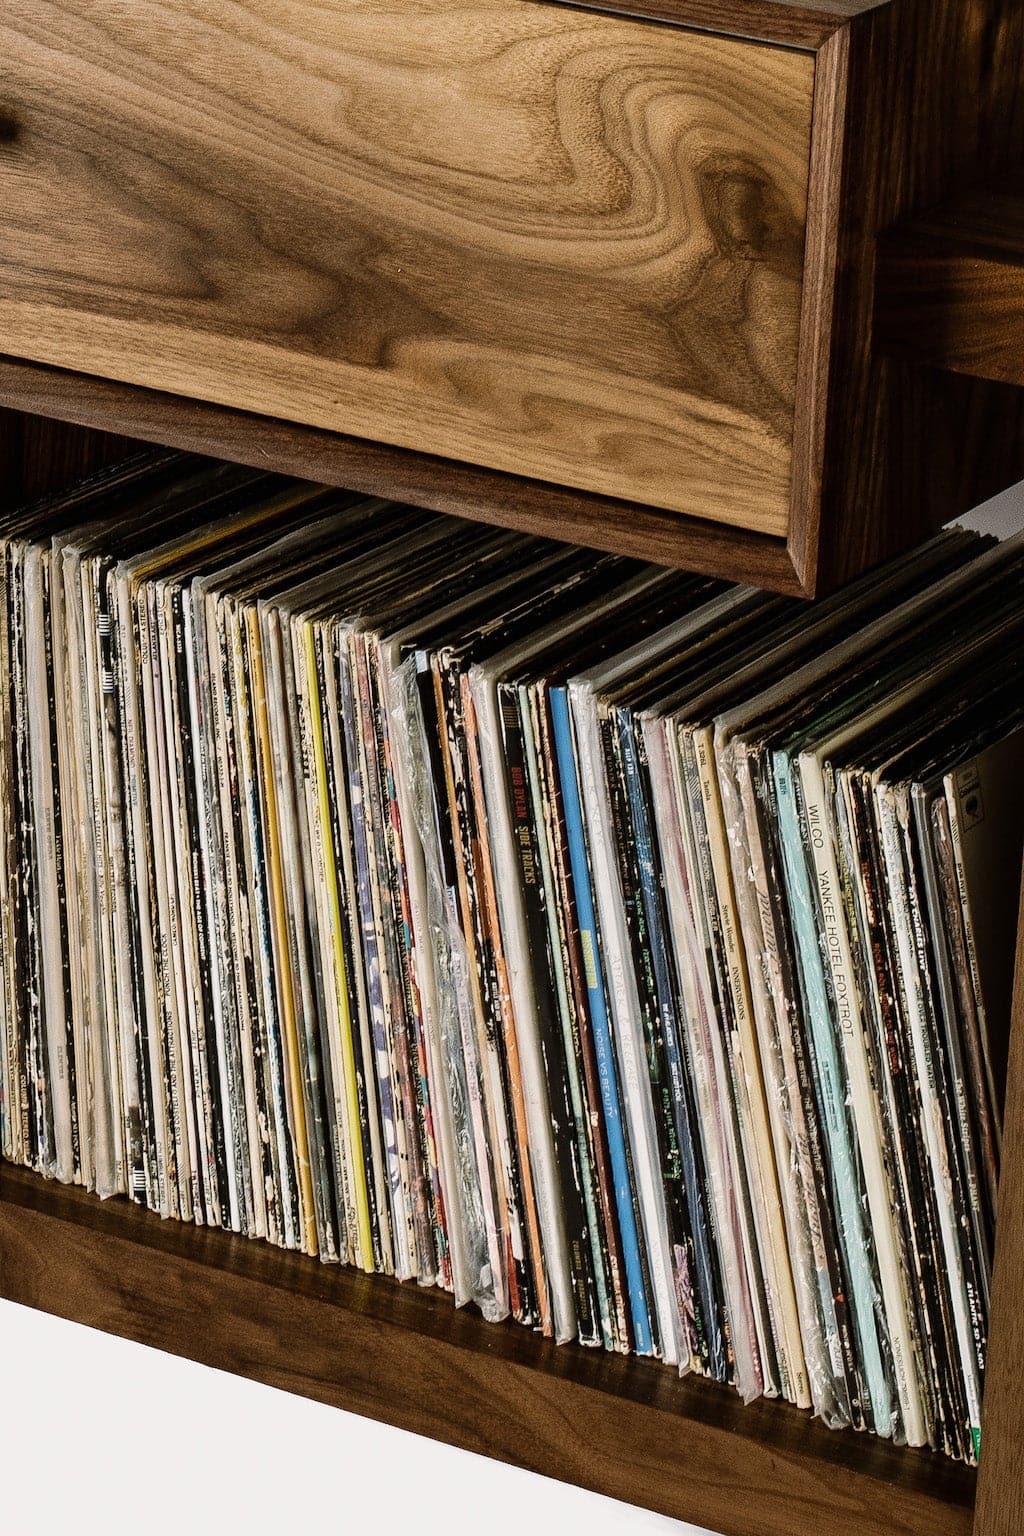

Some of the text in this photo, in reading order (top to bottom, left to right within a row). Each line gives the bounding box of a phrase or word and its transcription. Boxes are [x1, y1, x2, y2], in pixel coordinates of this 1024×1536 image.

[702, 779, 713, 802] Tamla
[511, 766, 535, 884] BOB DYLAN SIDE TRACKS
[694, 810, 706, 843] MICHAEL
[807, 804, 825, 849] WILCO
[699, 844, 712, 880] JACKSON
[817, 870, 837, 923] YANKEE
[826, 926, 844, 970] HOTEL
[162, 973, 172, 998] PUNCH
[724, 926, 736, 953] Wonder
[731, 966, 747, 1021] INNERVISIONS
[834, 974, 855, 1038] FOXTROT
[919, 1023, 933, 1062] TROUBLED
[594, 1027, 614, 1118] NOISE VS BEAUTY
[925, 1063, 936, 1089] WATER
[954, 1077, 973, 1152] The White Stripes
[965, 1281, 980, 1325] ATLANTIC
[971, 1326, 982, 1340] SD
